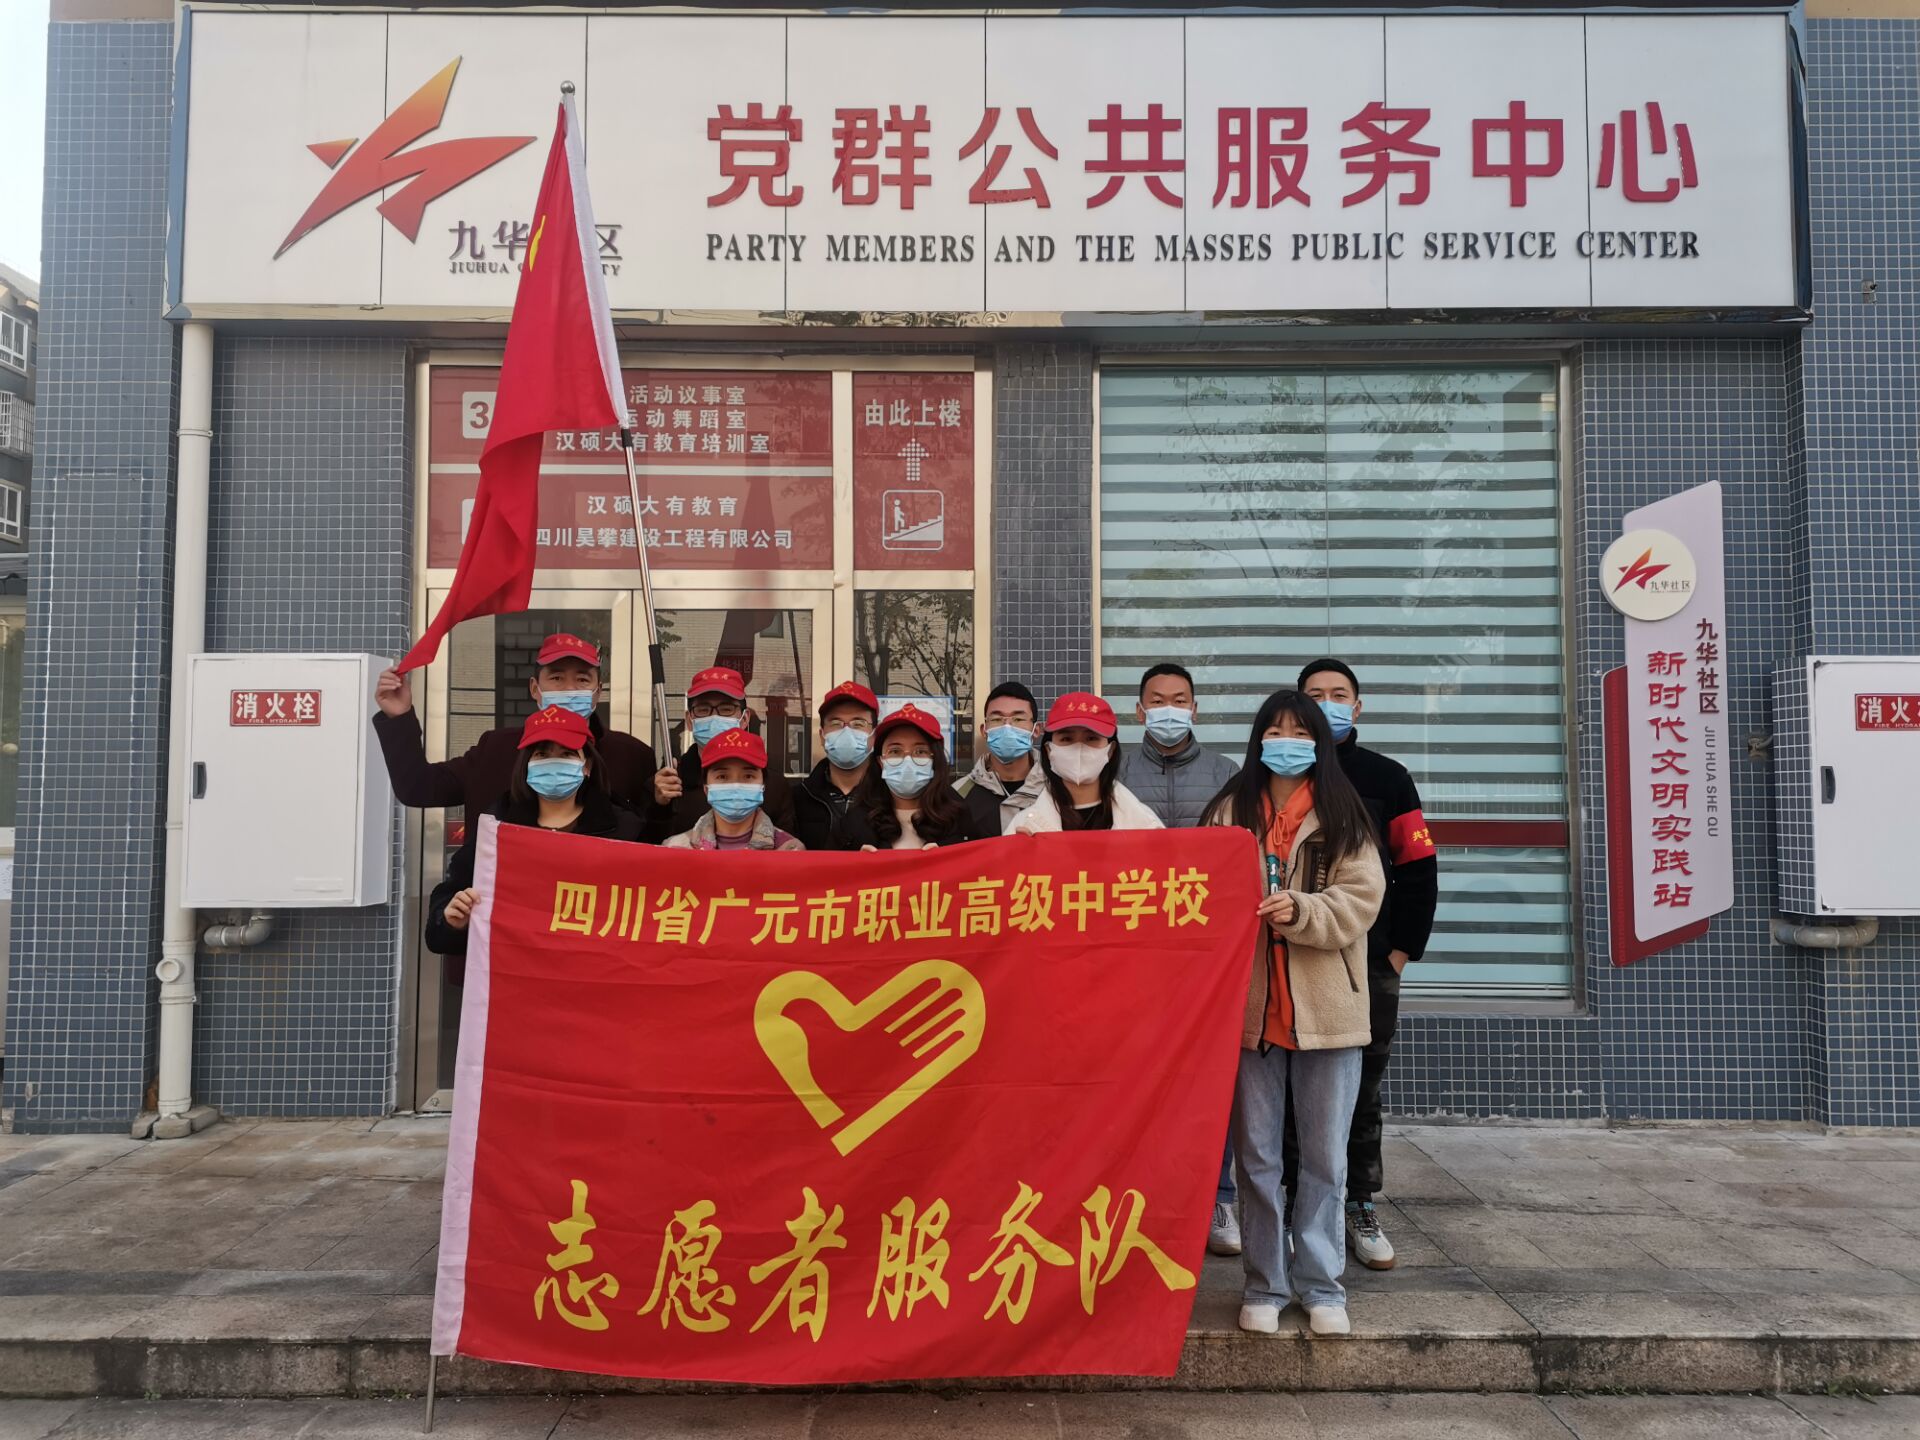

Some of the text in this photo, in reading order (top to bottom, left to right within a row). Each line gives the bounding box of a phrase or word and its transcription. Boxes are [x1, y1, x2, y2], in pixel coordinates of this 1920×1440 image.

[706, 101, 1699, 211] 党群公共服务中心
[448, 219, 624, 262] 九华区
[706, 231, 1700, 263] PARTY MEMBERS AND THE MASSES PUBLIC SERVICE CENTER
[449, 262, 510, 275] JIUHUA
[469, 401, 490, 429] 3
[865, 399, 961, 427] 由此上楼
[556, 431, 770, 454] 汉硕大有教育培训室
[587, 495, 738, 517] 汉硕大有教育
[1695, 618, 1720, 714] 九华社区
[235, 692, 316, 719] 消火栓
[1860, 696, 1920, 724] 消火
[1645, 650, 1695, 909] 新时代文明实践站
[1704, 726, 1719, 838] JIU HUA SHE QU
[549, 866, 1210, 945] 四川省广元市职业高级中学校
[533, 1178, 1197, 1343] 志愿者服务队
